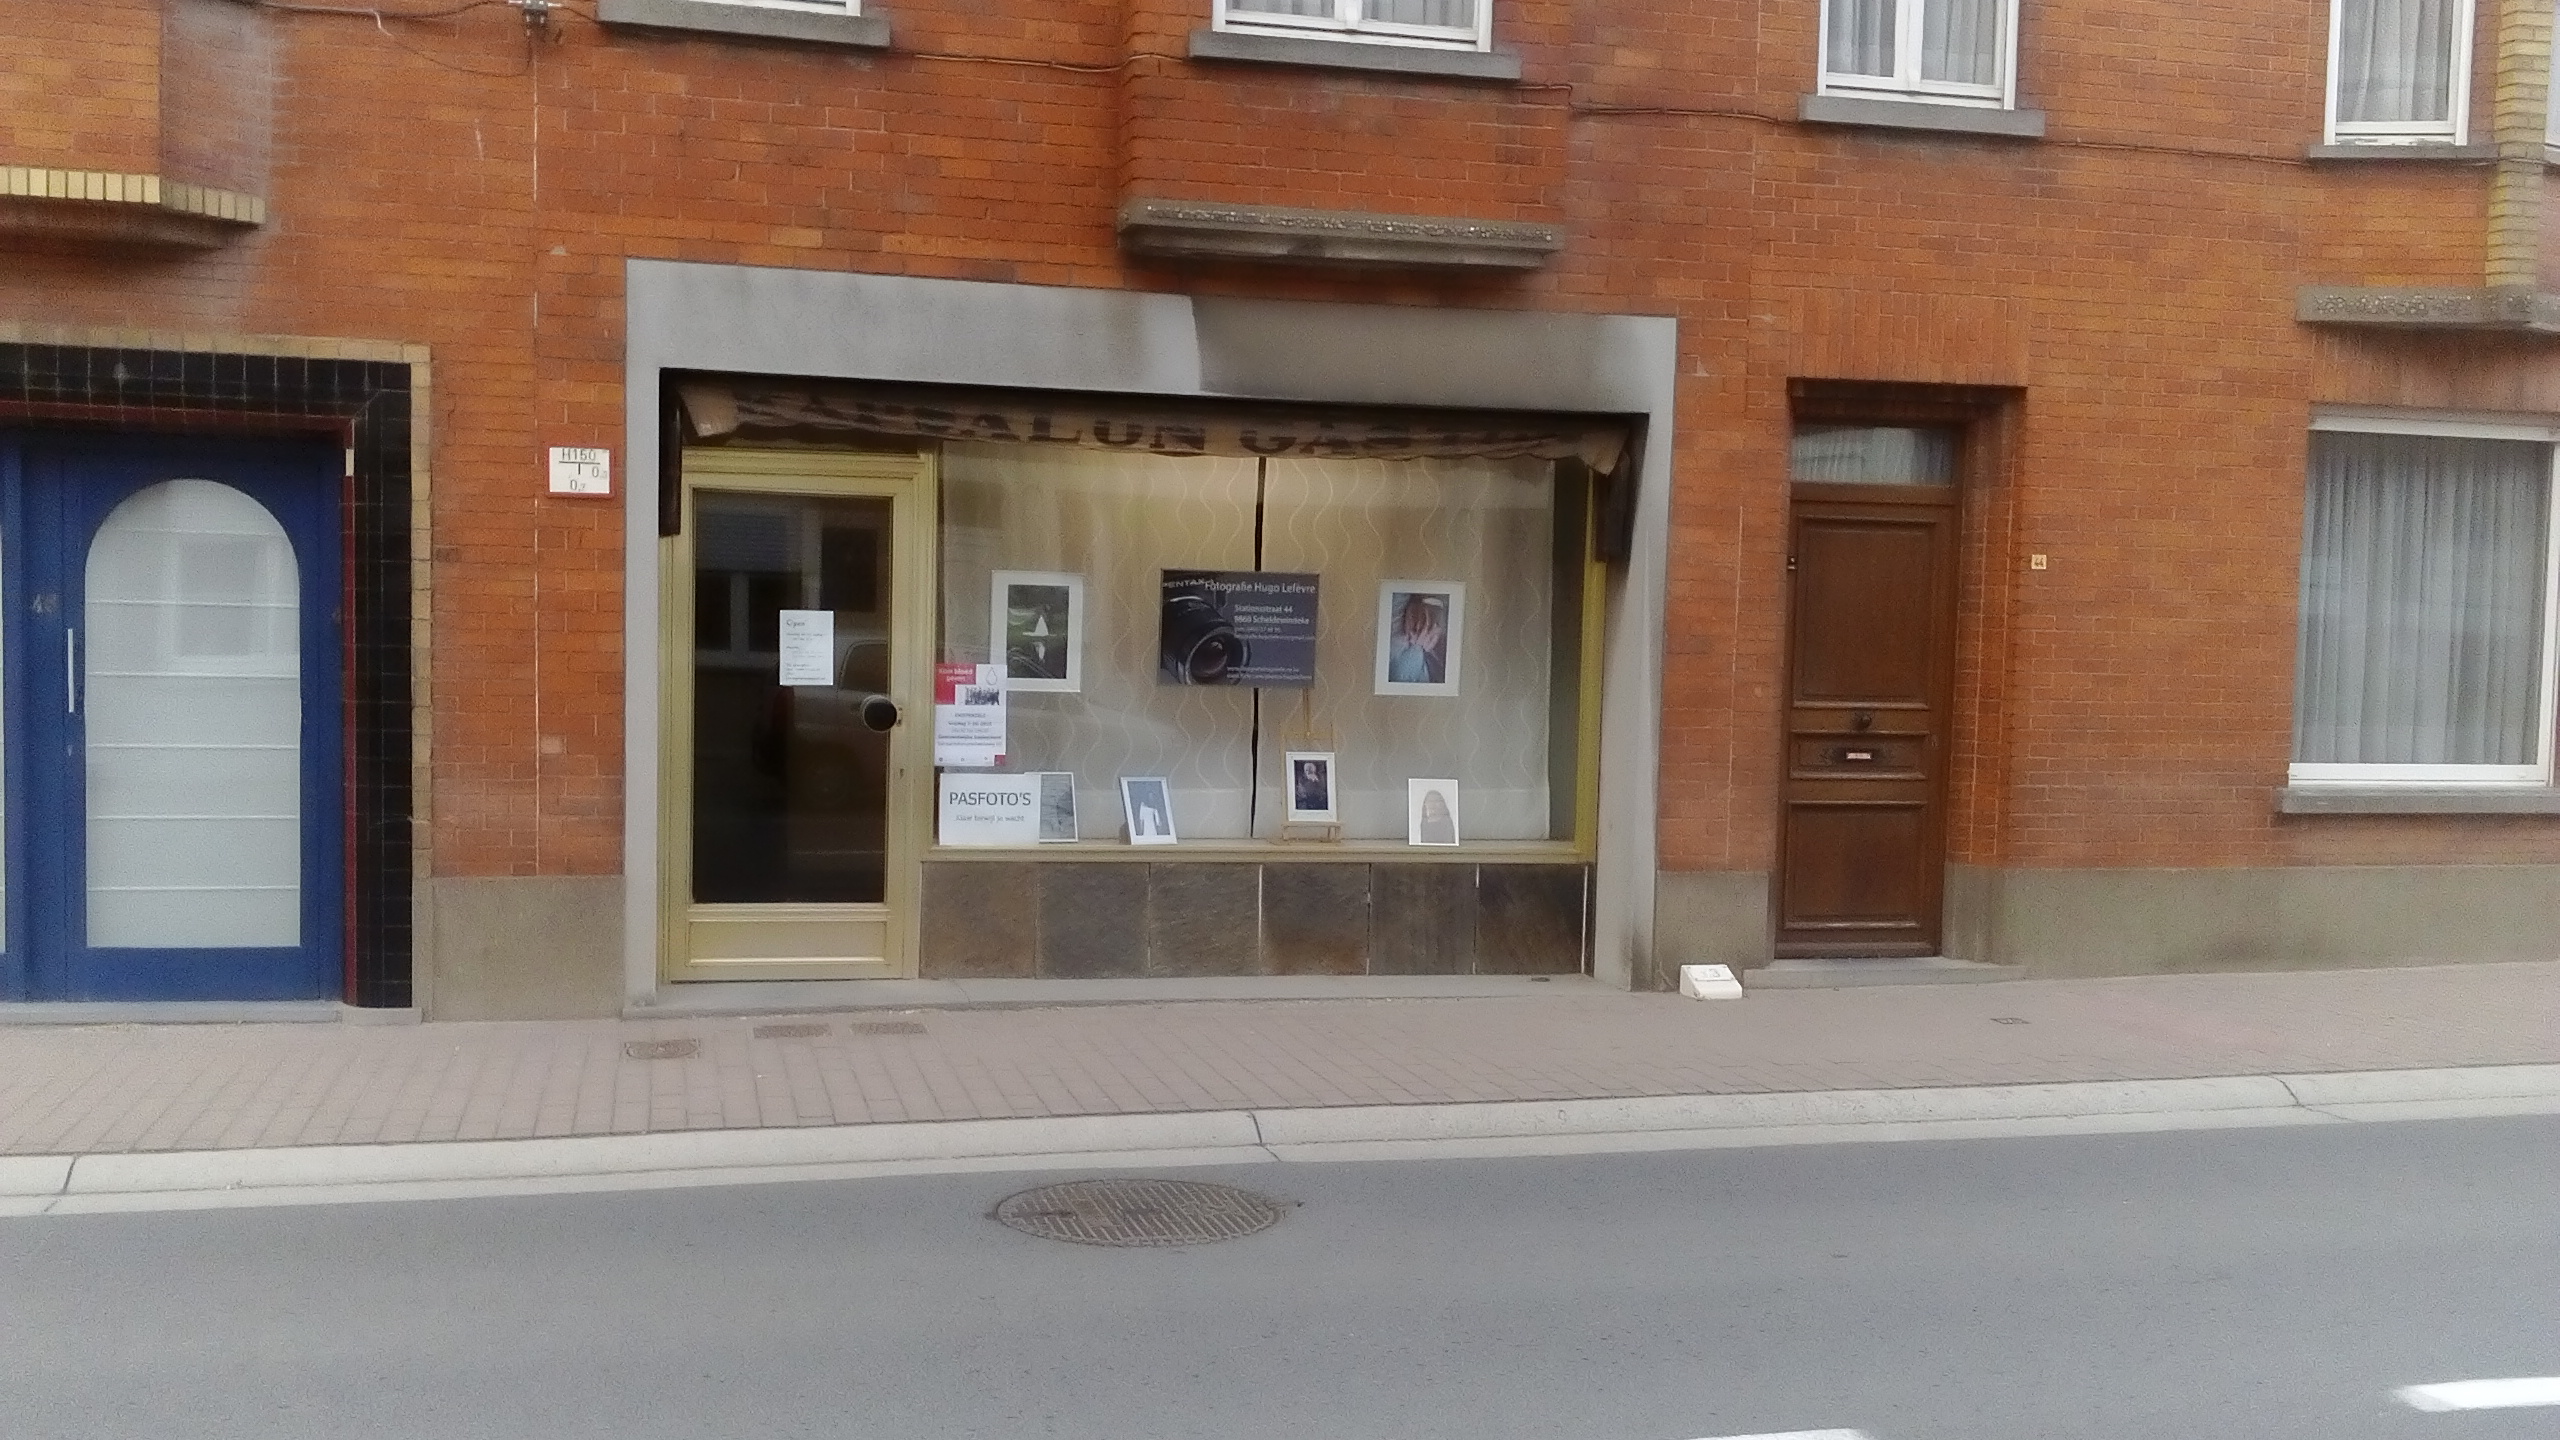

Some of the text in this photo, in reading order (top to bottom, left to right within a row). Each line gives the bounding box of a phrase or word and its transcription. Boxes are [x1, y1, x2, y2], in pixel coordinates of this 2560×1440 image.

[562, 449, 596, 461] H150
[1205, 582, 1252, 594] Fotografie
[1254, 583, 1280, 595] Hugo
[1283, 605, 1294, 614] 44
[949, 791, 1032, 806] PASFOTO'S
